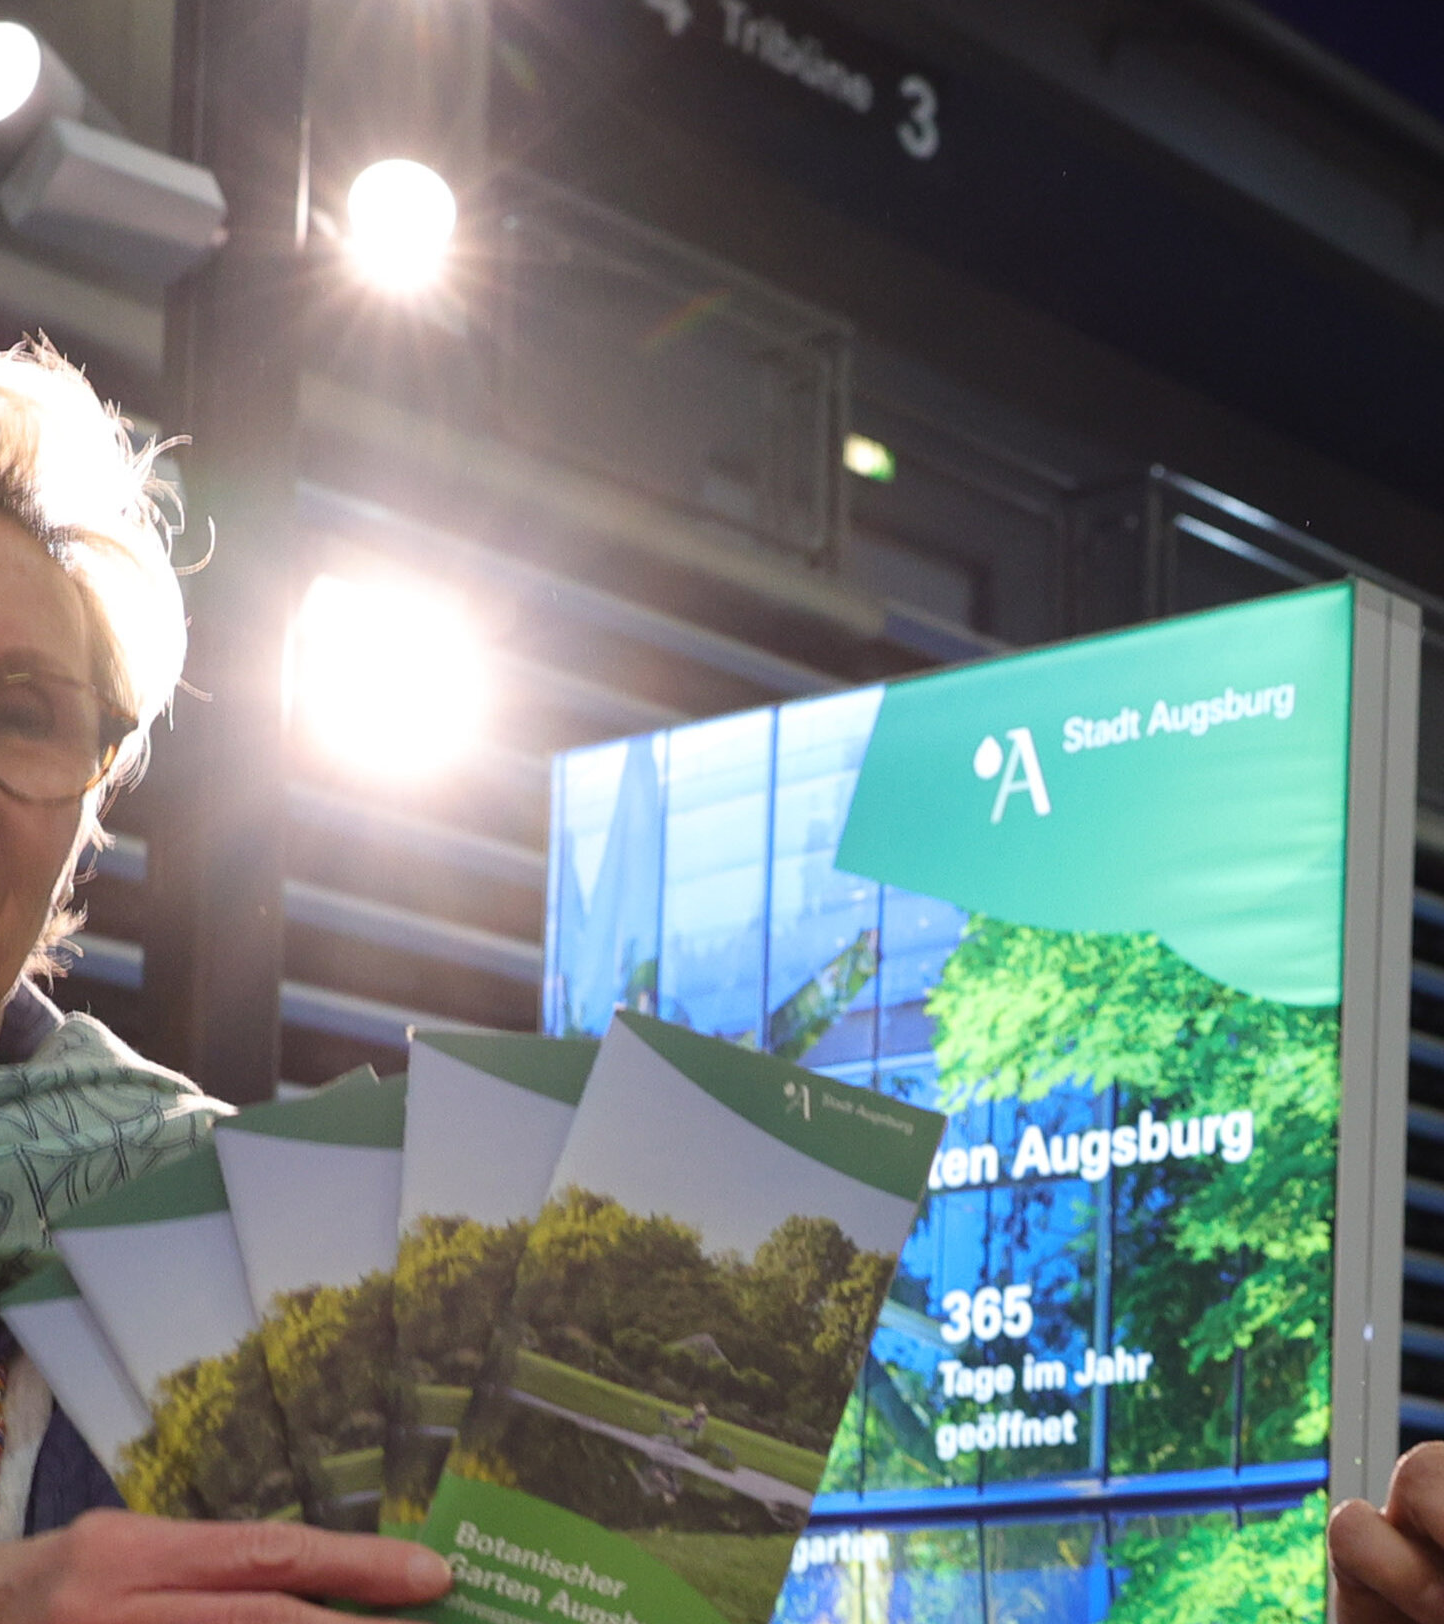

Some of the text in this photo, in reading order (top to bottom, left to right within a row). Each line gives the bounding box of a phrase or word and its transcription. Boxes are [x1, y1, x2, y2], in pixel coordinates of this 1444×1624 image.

[896, 72, 940, 161] 3
[1062, 683, 1296, 753] Stadt Augsburg
[1011, 1109, 1254, 1182] Augsburg
[940, 1284, 1033, 1345] 365
[937, 1345, 1154, 1403] Tage im Jahr
[936, 1411, 1078, 1462] geöffnet
[442, 1551, 541, 1607] Garten
[456, 1520, 627, 1599] Botanischer
